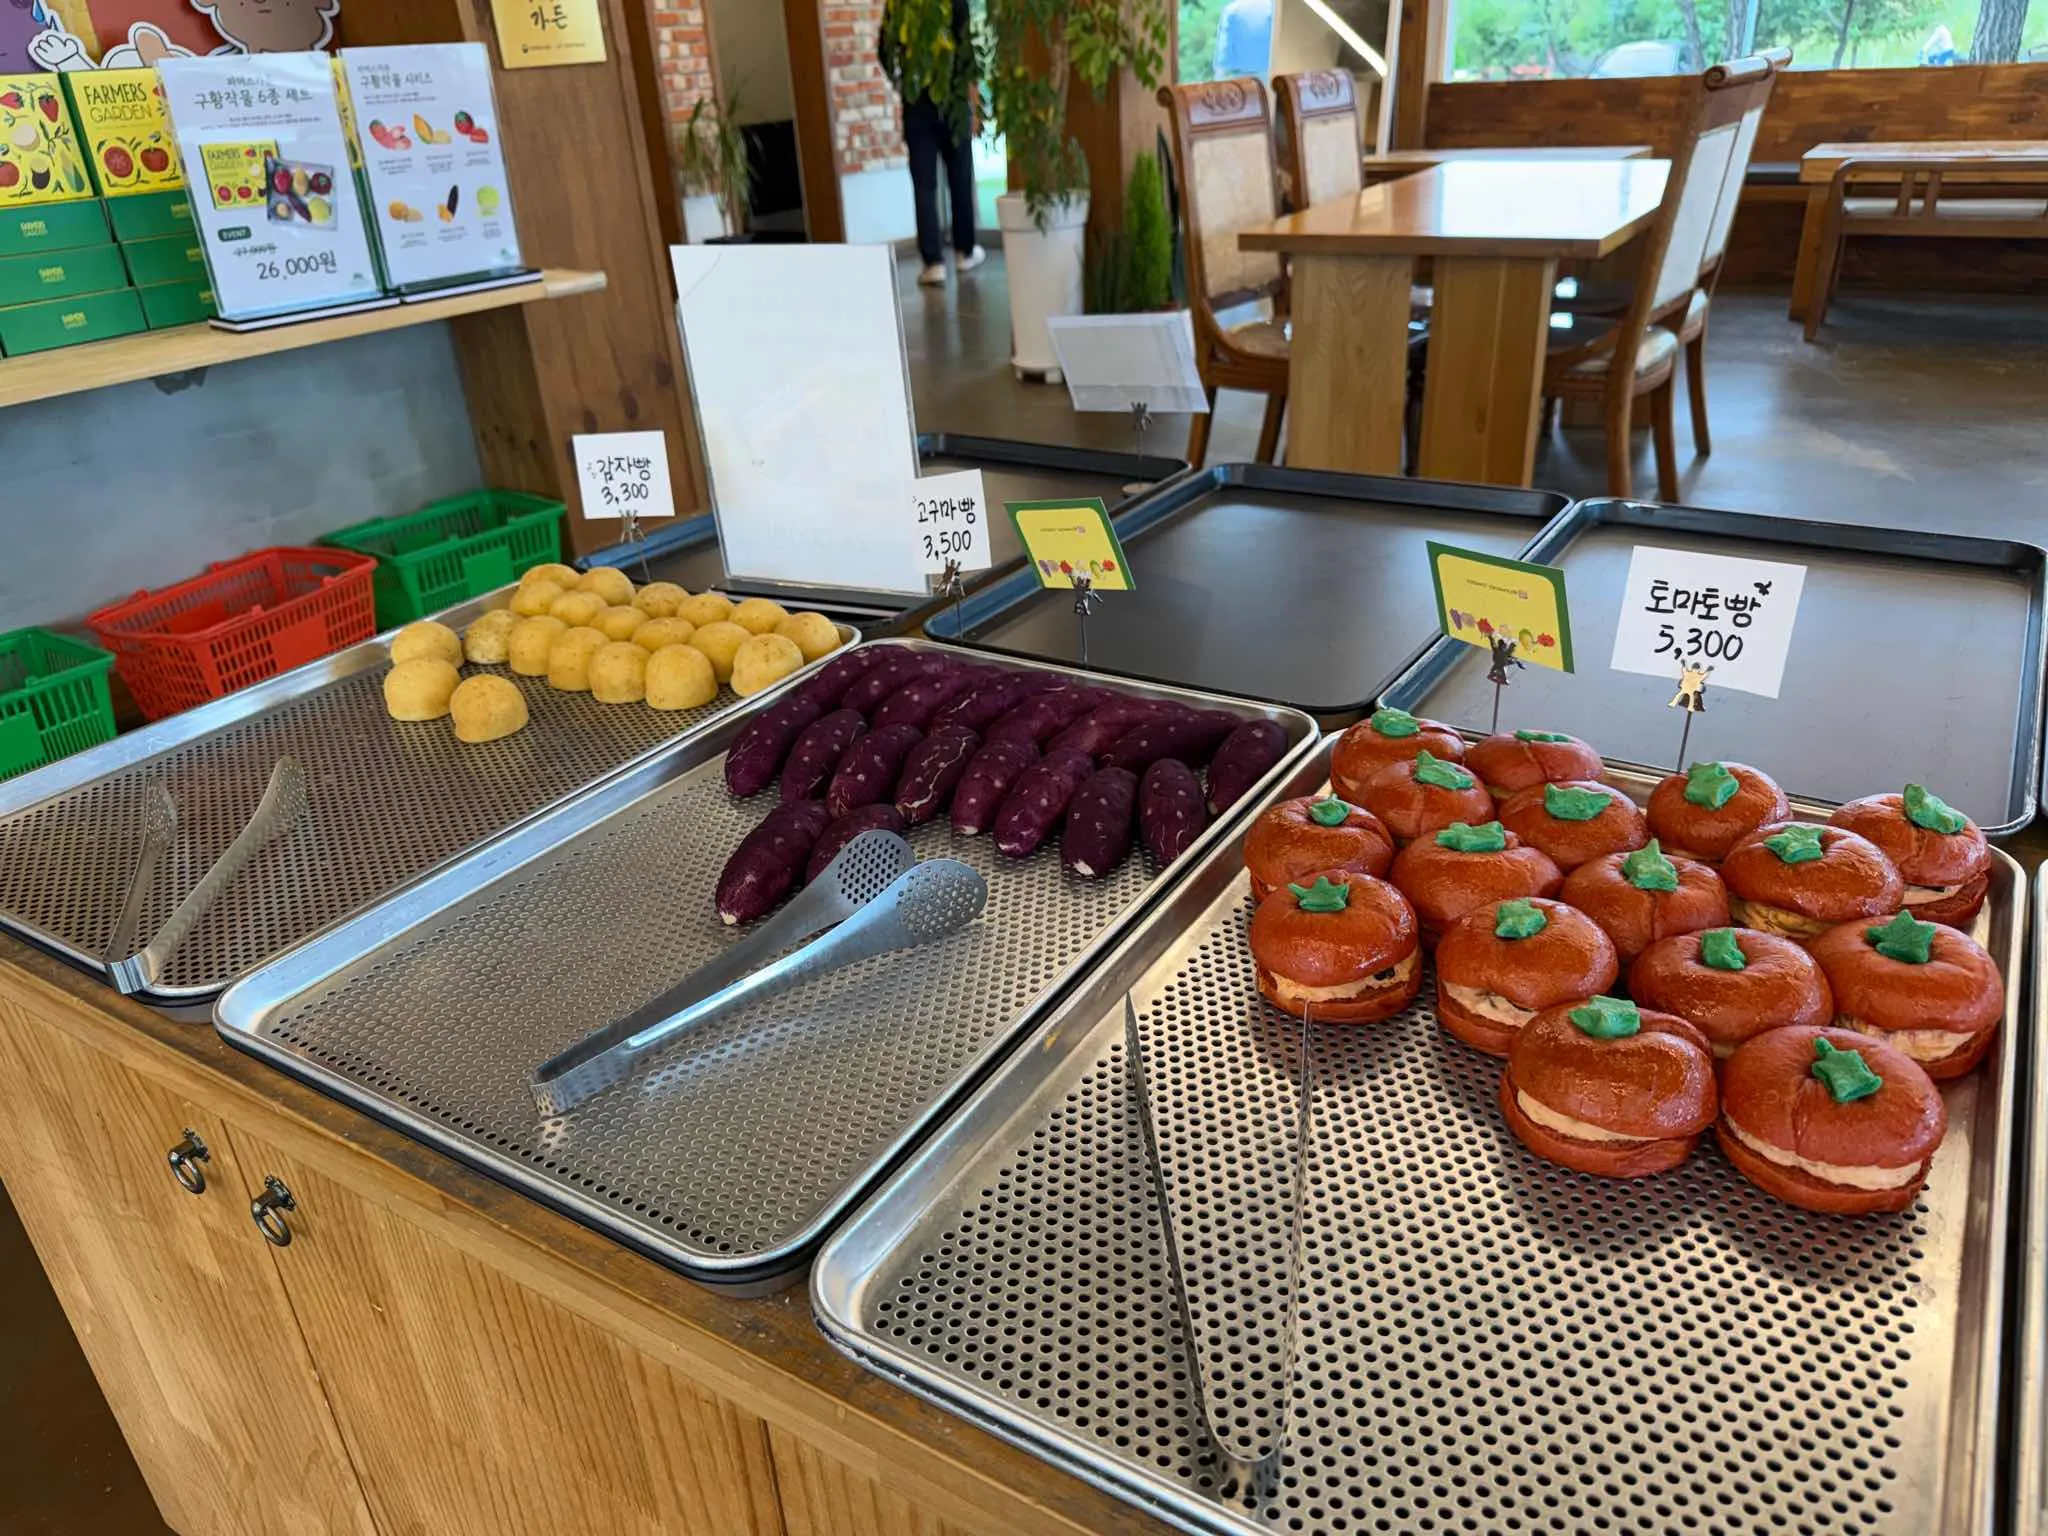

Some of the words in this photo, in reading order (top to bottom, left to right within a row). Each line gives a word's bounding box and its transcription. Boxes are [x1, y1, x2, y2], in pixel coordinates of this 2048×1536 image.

[530, 4, 568, 31] 가든
[404, 72, 434, 86] 시리즈
[83, 82, 147, 106] FARMERS
[194, 89, 254, 111] 구황작물
[258, 87, 281, 106] 6종
[285, 87, 313, 103] 세트
[89, 104, 153, 123] GARDEN
[221, 229, 248, 240] EVENT
[256, 250, 338, 280] 26,000원
[596, 455, 652, 484] 감자빵
[601, 482, 649, 505] 3,300
[923, 529, 972, 560] 3,500
[1645, 579, 1762, 628] 토마토빵
[1654, 624, 1744, 661] 5,300
